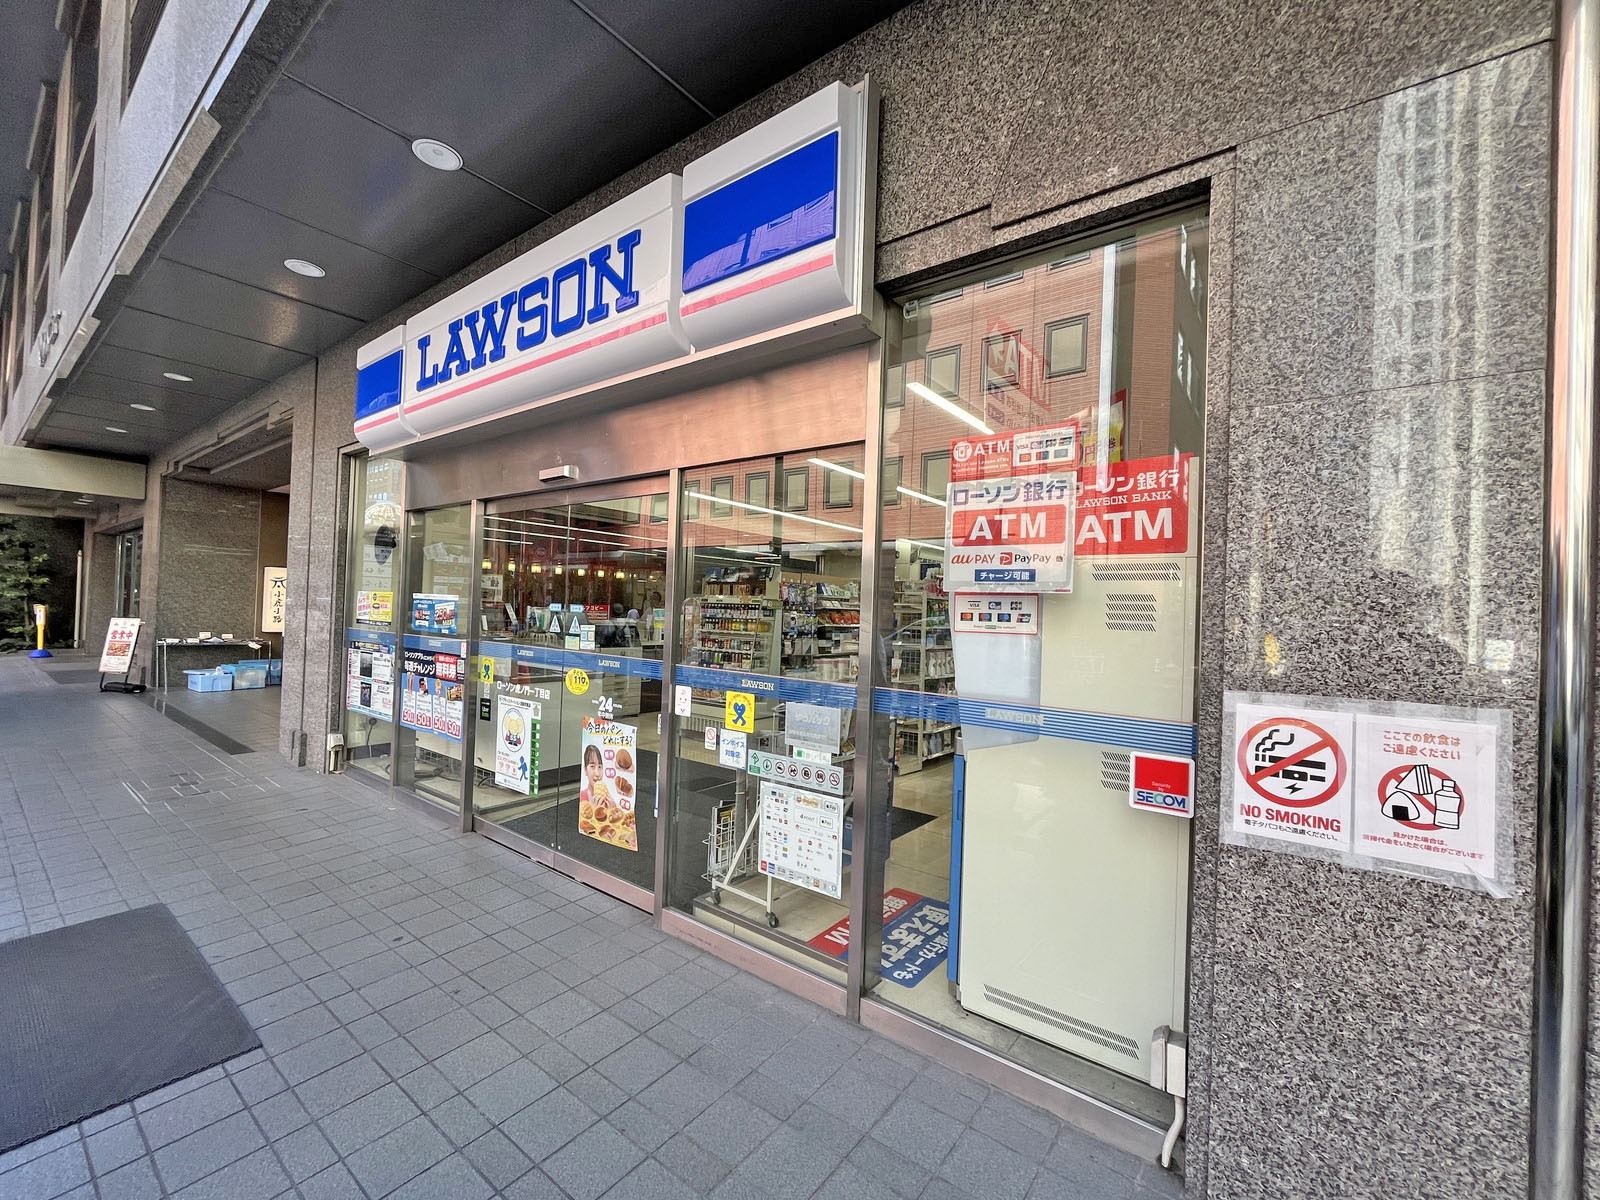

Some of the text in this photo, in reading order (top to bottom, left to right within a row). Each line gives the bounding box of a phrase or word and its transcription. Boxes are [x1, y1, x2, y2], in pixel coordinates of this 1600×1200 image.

[416, 229, 641, 391] LAWSON
[974, 440, 1010, 456] ATM
[954, 480, 1067, 505] ローソン銀行
[1132, 490, 1172, 503] BANK
[969, 512, 1047, 540] ATM
[1076, 507, 1173, 545] ATM
[975, 554, 995, 564] PAY
[1014, 553, 1051, 566] PayPay
[980, 571, 1030, 580] チャージ可能
[111, 630, 133, 640] 営業中
[742, 679, 774, 690] LAWSON
[599, 696, 613, 712] 24
[985, 708, 1044, 725] LAWSON
[1384, 731, 1460, 747] ここでの飲食は
[1384, 743, 1461, 760] ご遠慮ください
[1137, 791, 1186, 809] SECOM
[1240, 804, 1341, 832] NO SMOKING
